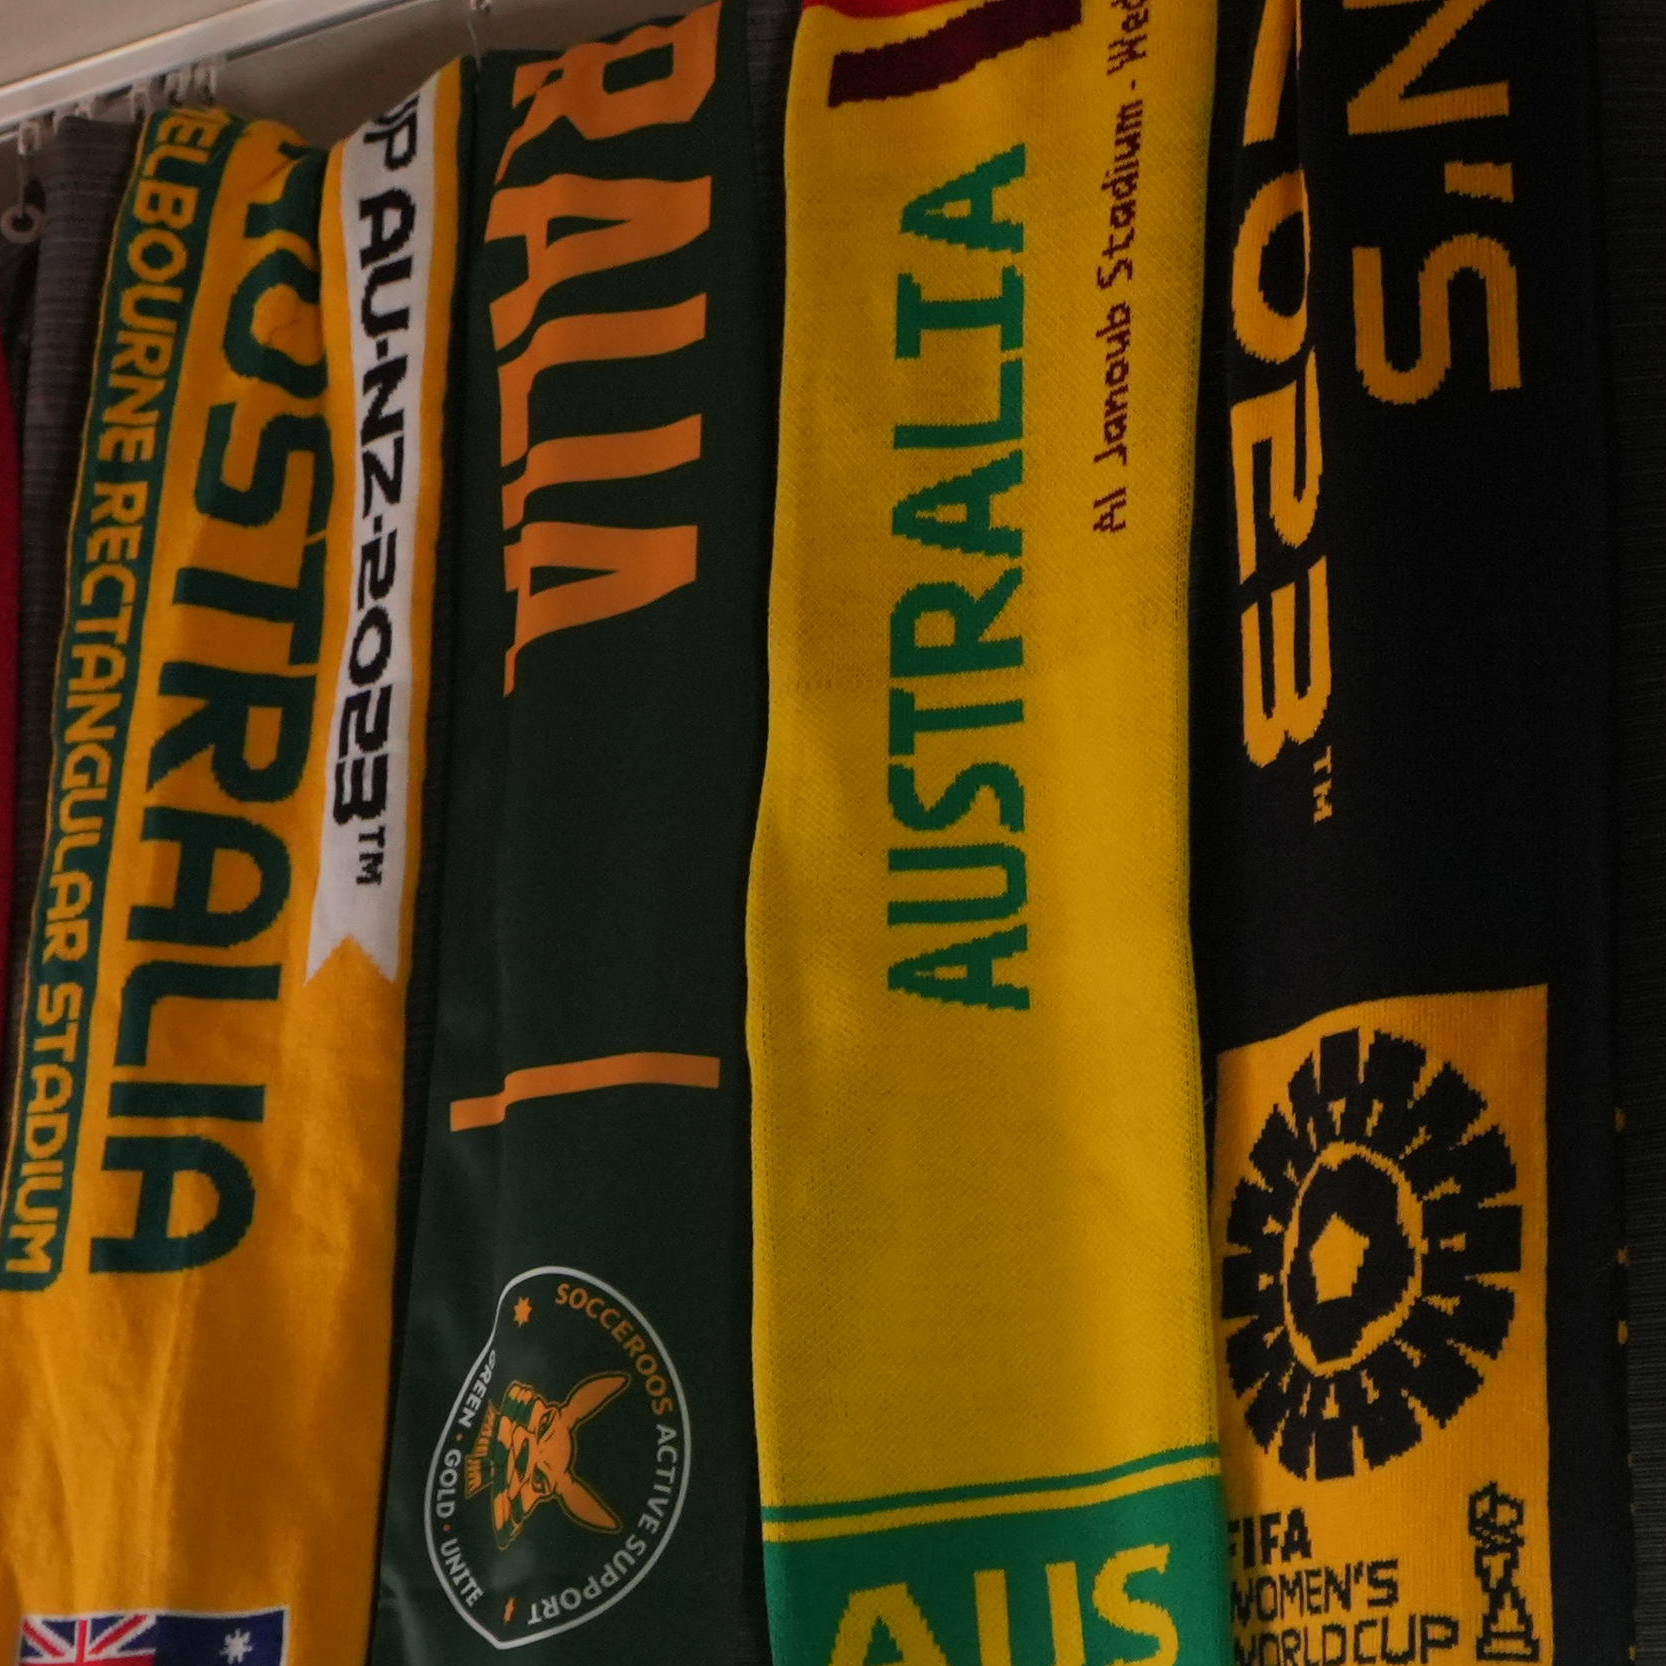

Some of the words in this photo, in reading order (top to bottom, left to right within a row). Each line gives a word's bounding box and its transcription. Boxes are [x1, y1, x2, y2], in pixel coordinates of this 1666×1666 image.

[1097, 99, 1144, 290] Stadium
[1093, 301, 1131, 467] Janoub
[1093, 485, 1126, 534] Al
[887, 142, 1030, 1012] AUSTRALIA
[40, 481, 149, 963] RECTANGULAR
[5, 981, 84, 1275] STADIUM
[457, 1349, 496, 1428] GREEN
[555, 1283, 674, 1416] SOCCEROOS
[436, 1448, 462, 1519] GOLD
[637, 1423, 678, 1535] ACTIVE
[440, 1538, 485, 1608] UNITE
[528, 1534, 647, 1626] SUPPORT
[1231, 1558, 1400, 1627] WOMEN'S
